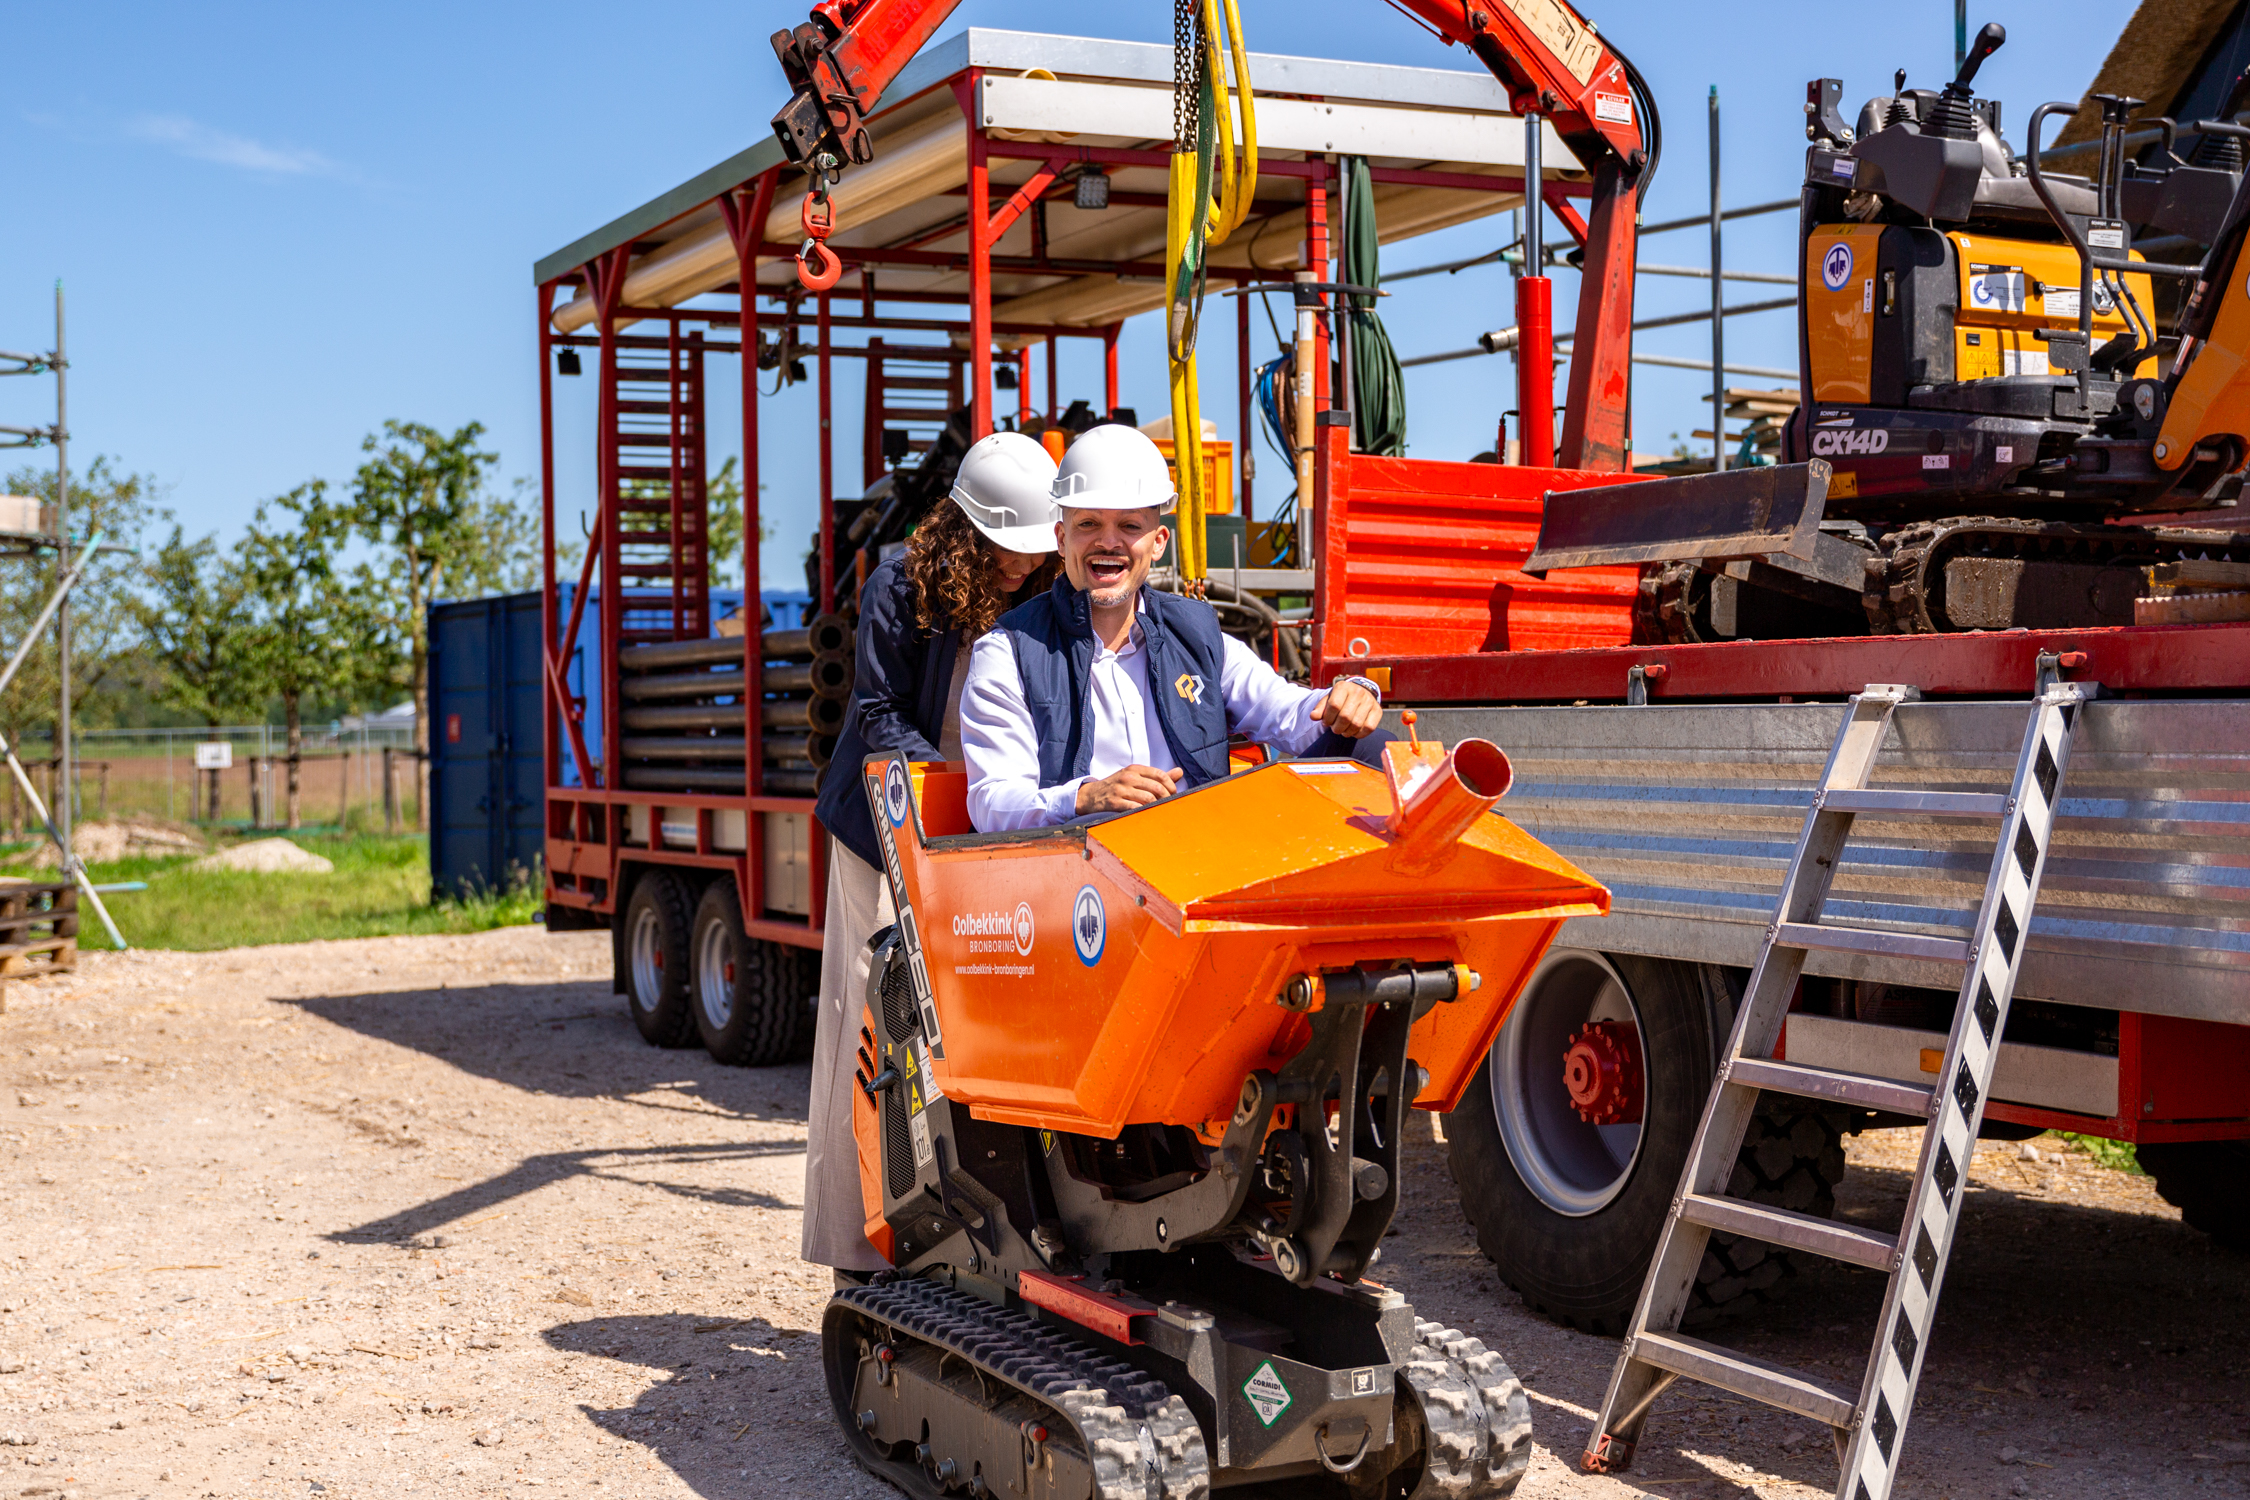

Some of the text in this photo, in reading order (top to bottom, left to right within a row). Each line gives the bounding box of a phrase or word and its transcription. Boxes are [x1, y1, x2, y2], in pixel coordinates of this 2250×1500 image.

[1812, 429, 1889, 456] CX14D
[873, 782, 904, 895] CORMIDI
[900, 903, 942, 1048] C60
[952, 911, 1013, 936] Oolbekkink
[969, 940, 1015, 953] BRONBORING
[955, 963, 1035, 979] www.oolbekkink-bronboringen.nl
[1252, 1378, 1281, 1391] CORMIDI
